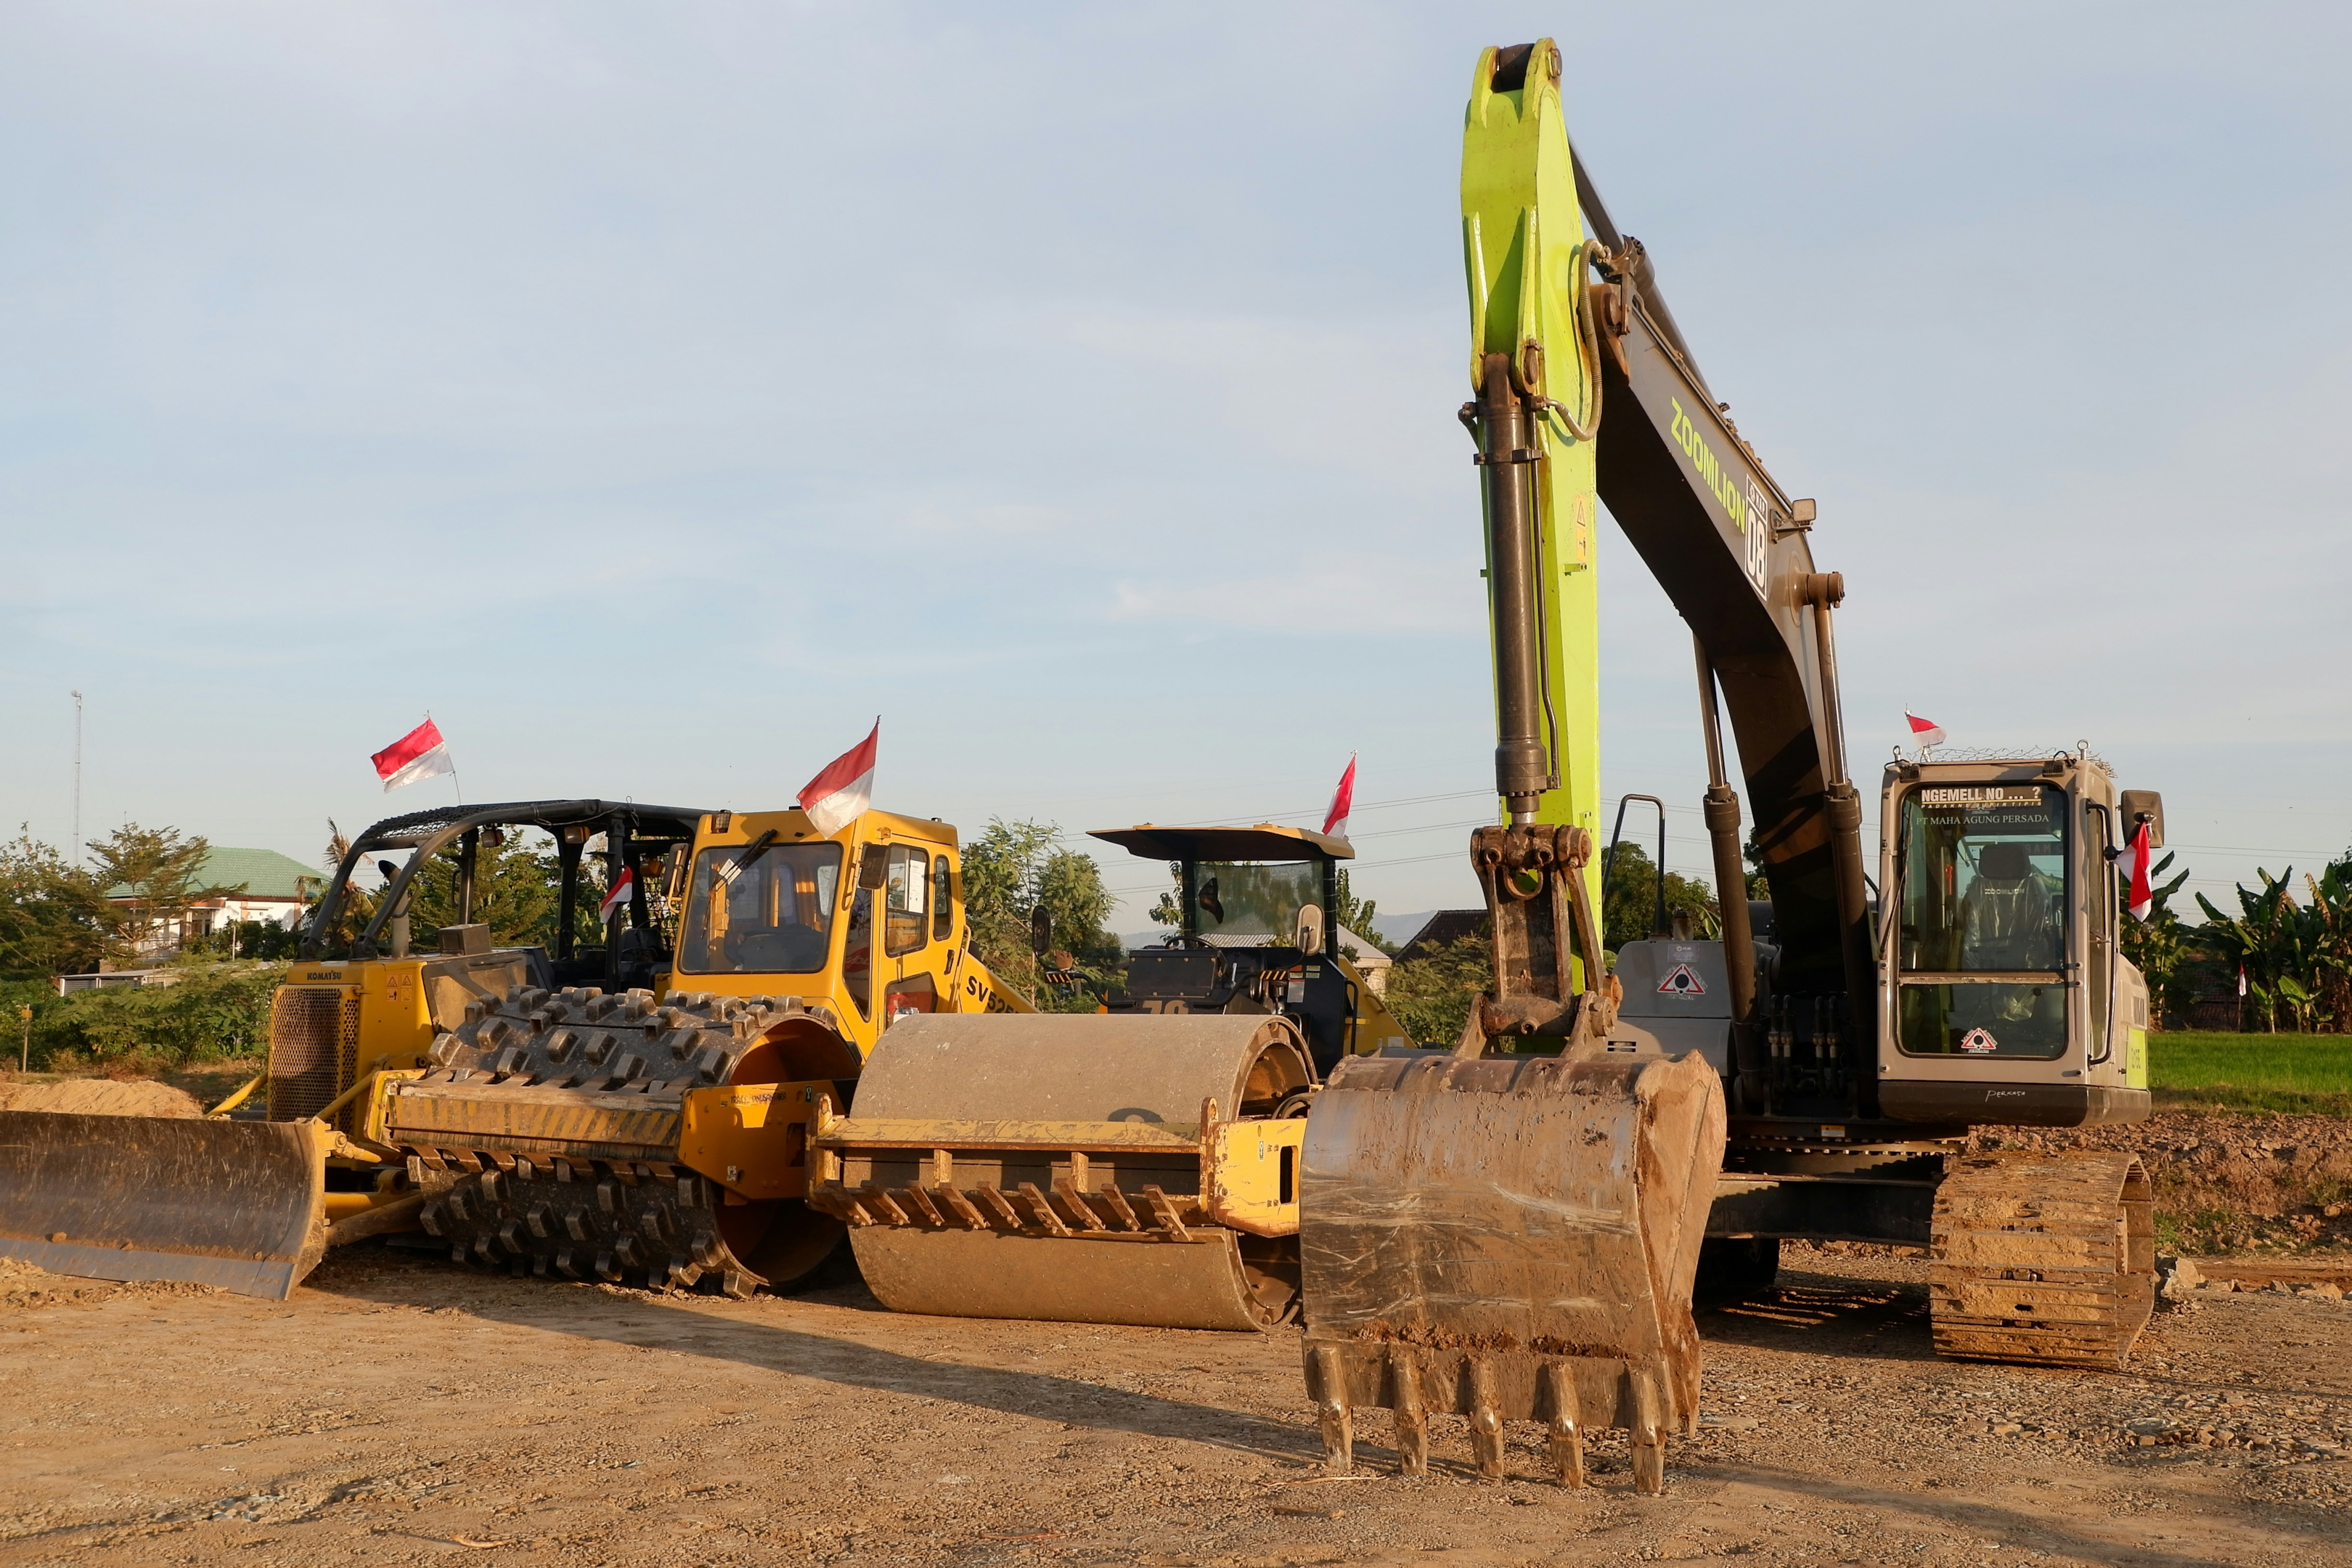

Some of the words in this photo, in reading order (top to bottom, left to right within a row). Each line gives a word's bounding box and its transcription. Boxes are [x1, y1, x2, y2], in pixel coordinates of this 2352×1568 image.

[1671, 396, 1745, 534] ZOOMLION
[1747, 507, 1765, 588] 08
[1922, 788, 1982, 802] NGEMELL
[1986, 788, 2004, 800] NO
[1963, 815, 2000, 825] AGUNG
[2003, 814, 2049, 823] PERSADA
[307, 970, 342, 980] KOMATSU
[1985, 1090, 2025, 1103] PERKASA
